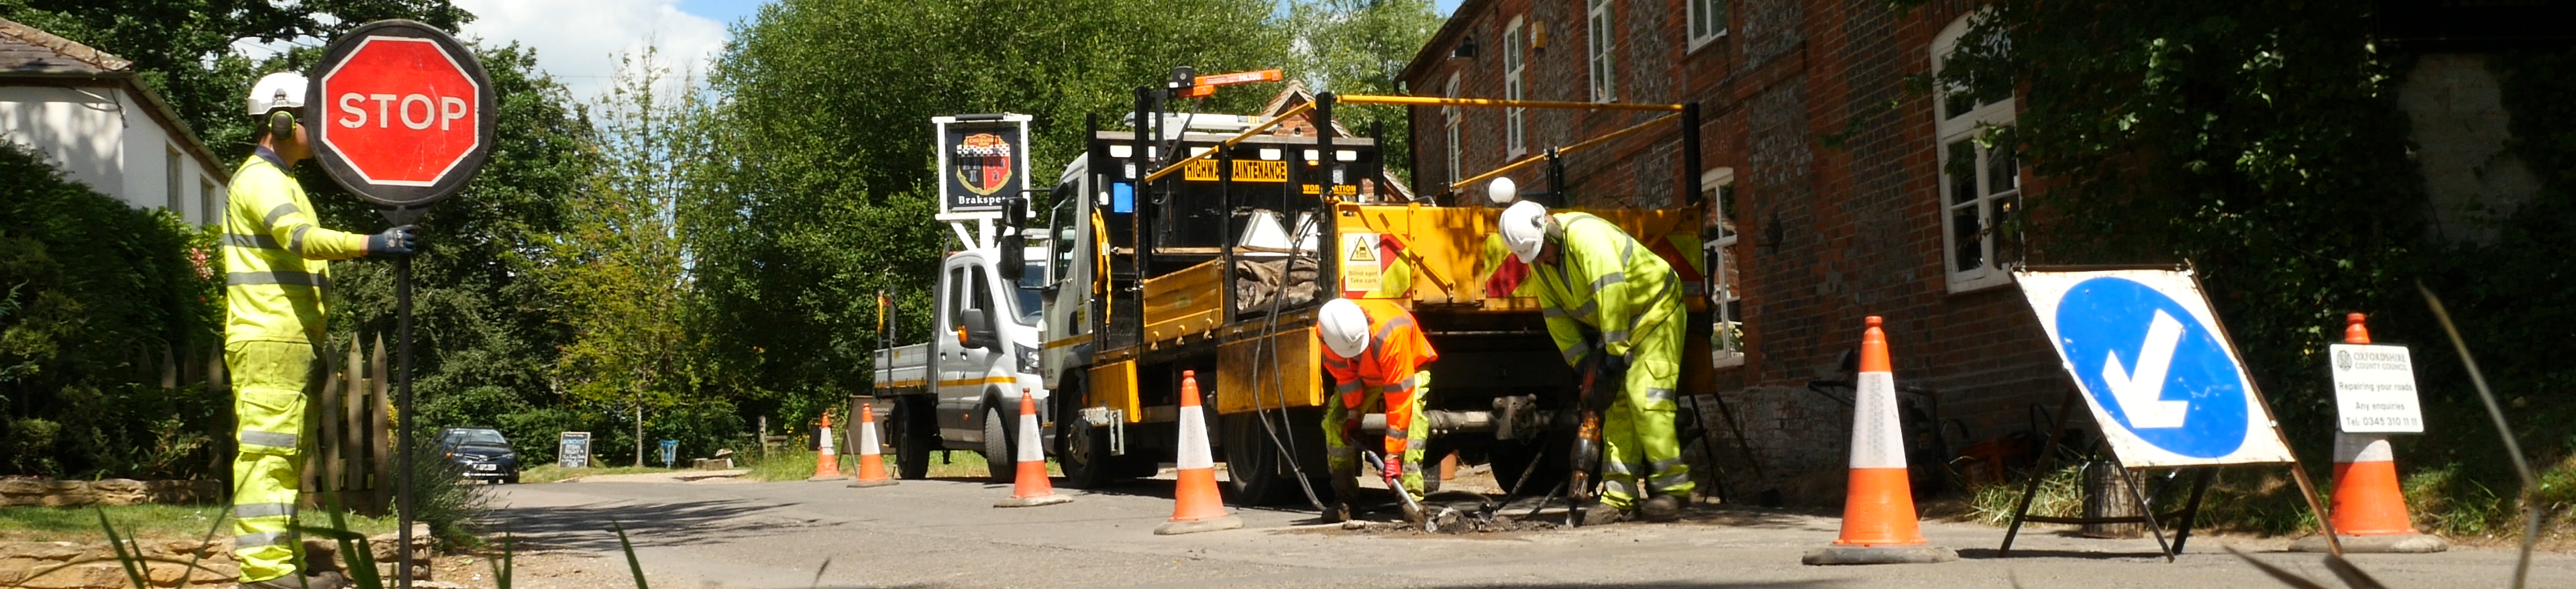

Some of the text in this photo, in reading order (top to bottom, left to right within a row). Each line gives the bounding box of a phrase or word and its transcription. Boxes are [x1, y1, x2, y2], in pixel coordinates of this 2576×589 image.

[339, 93, 467, 131] STOP
[1187, 161, 1285, 179] HIGHWA AINTENANCE
[959, 195, 1006, 205] Brakspe
[2353, 352, 2406, 362] OXFORDSHIRE
[2339, 382, 2413, 392] Repairing your roads
[2355, 402, 2405, 411] Any enquiries
[2363, 417, 2385, 426] 0345
[2387, 417, 2401, 426] 310
[2403, 418, 2410, 426] 11
[2411, 418, 2418, 426] 11
